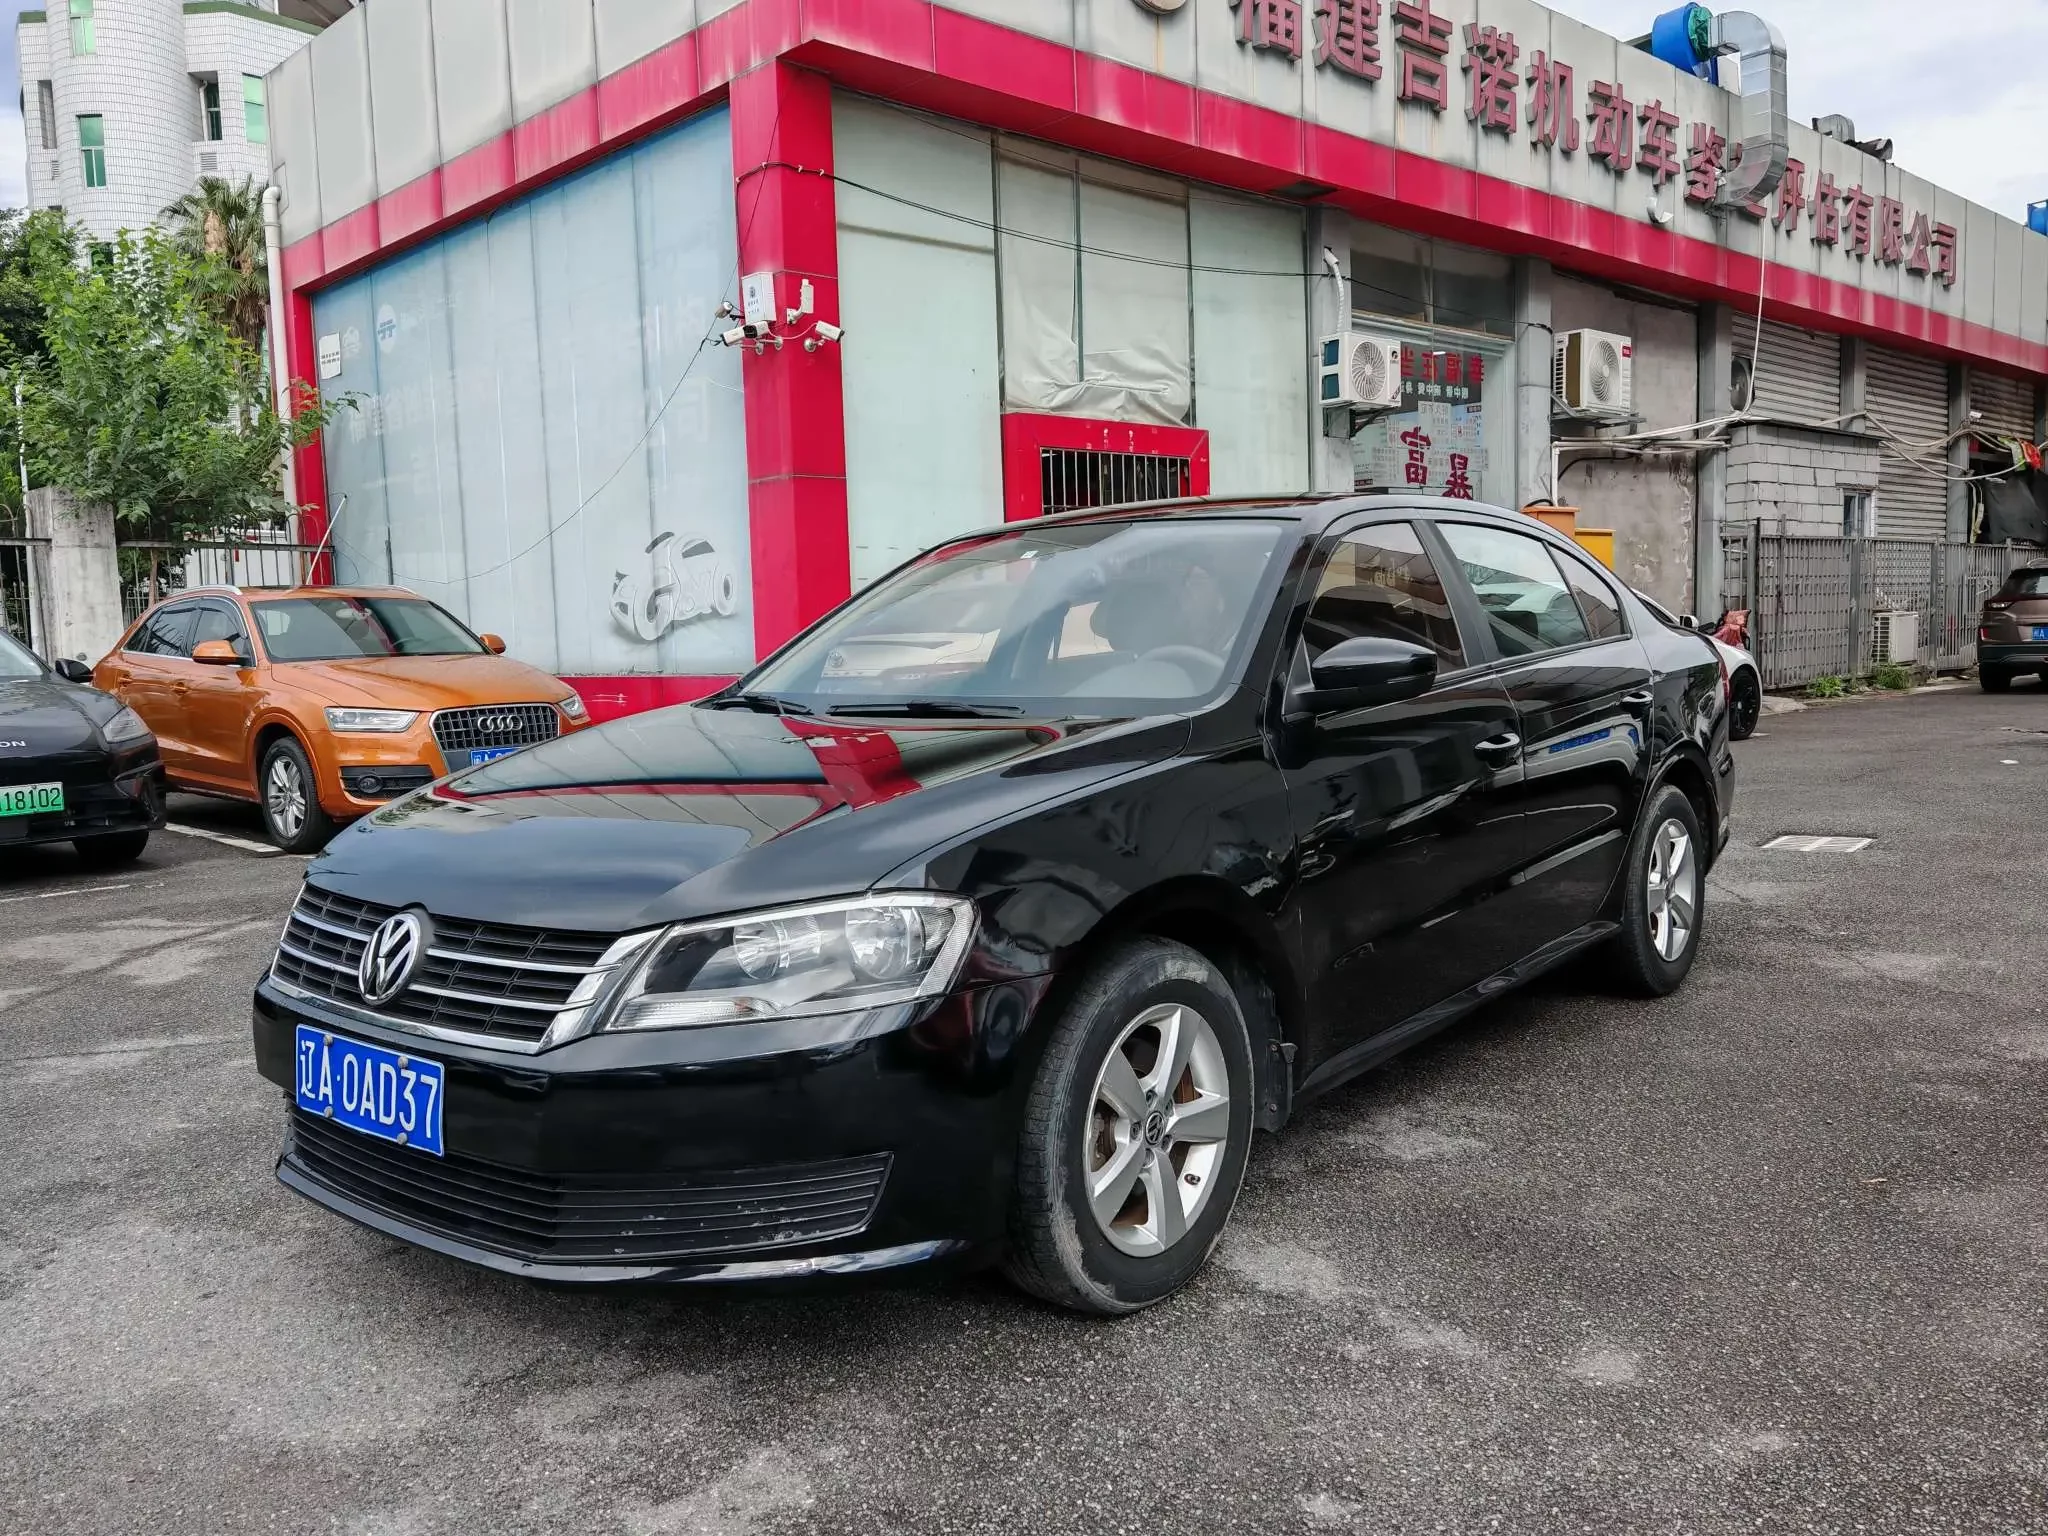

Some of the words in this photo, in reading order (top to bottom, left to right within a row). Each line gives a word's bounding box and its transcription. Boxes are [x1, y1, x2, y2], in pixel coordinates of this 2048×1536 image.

[1231, 0, 1957, 287] 建吉诺机动车鉴评估有限公司
[0, 787, 61, 811] 18102
